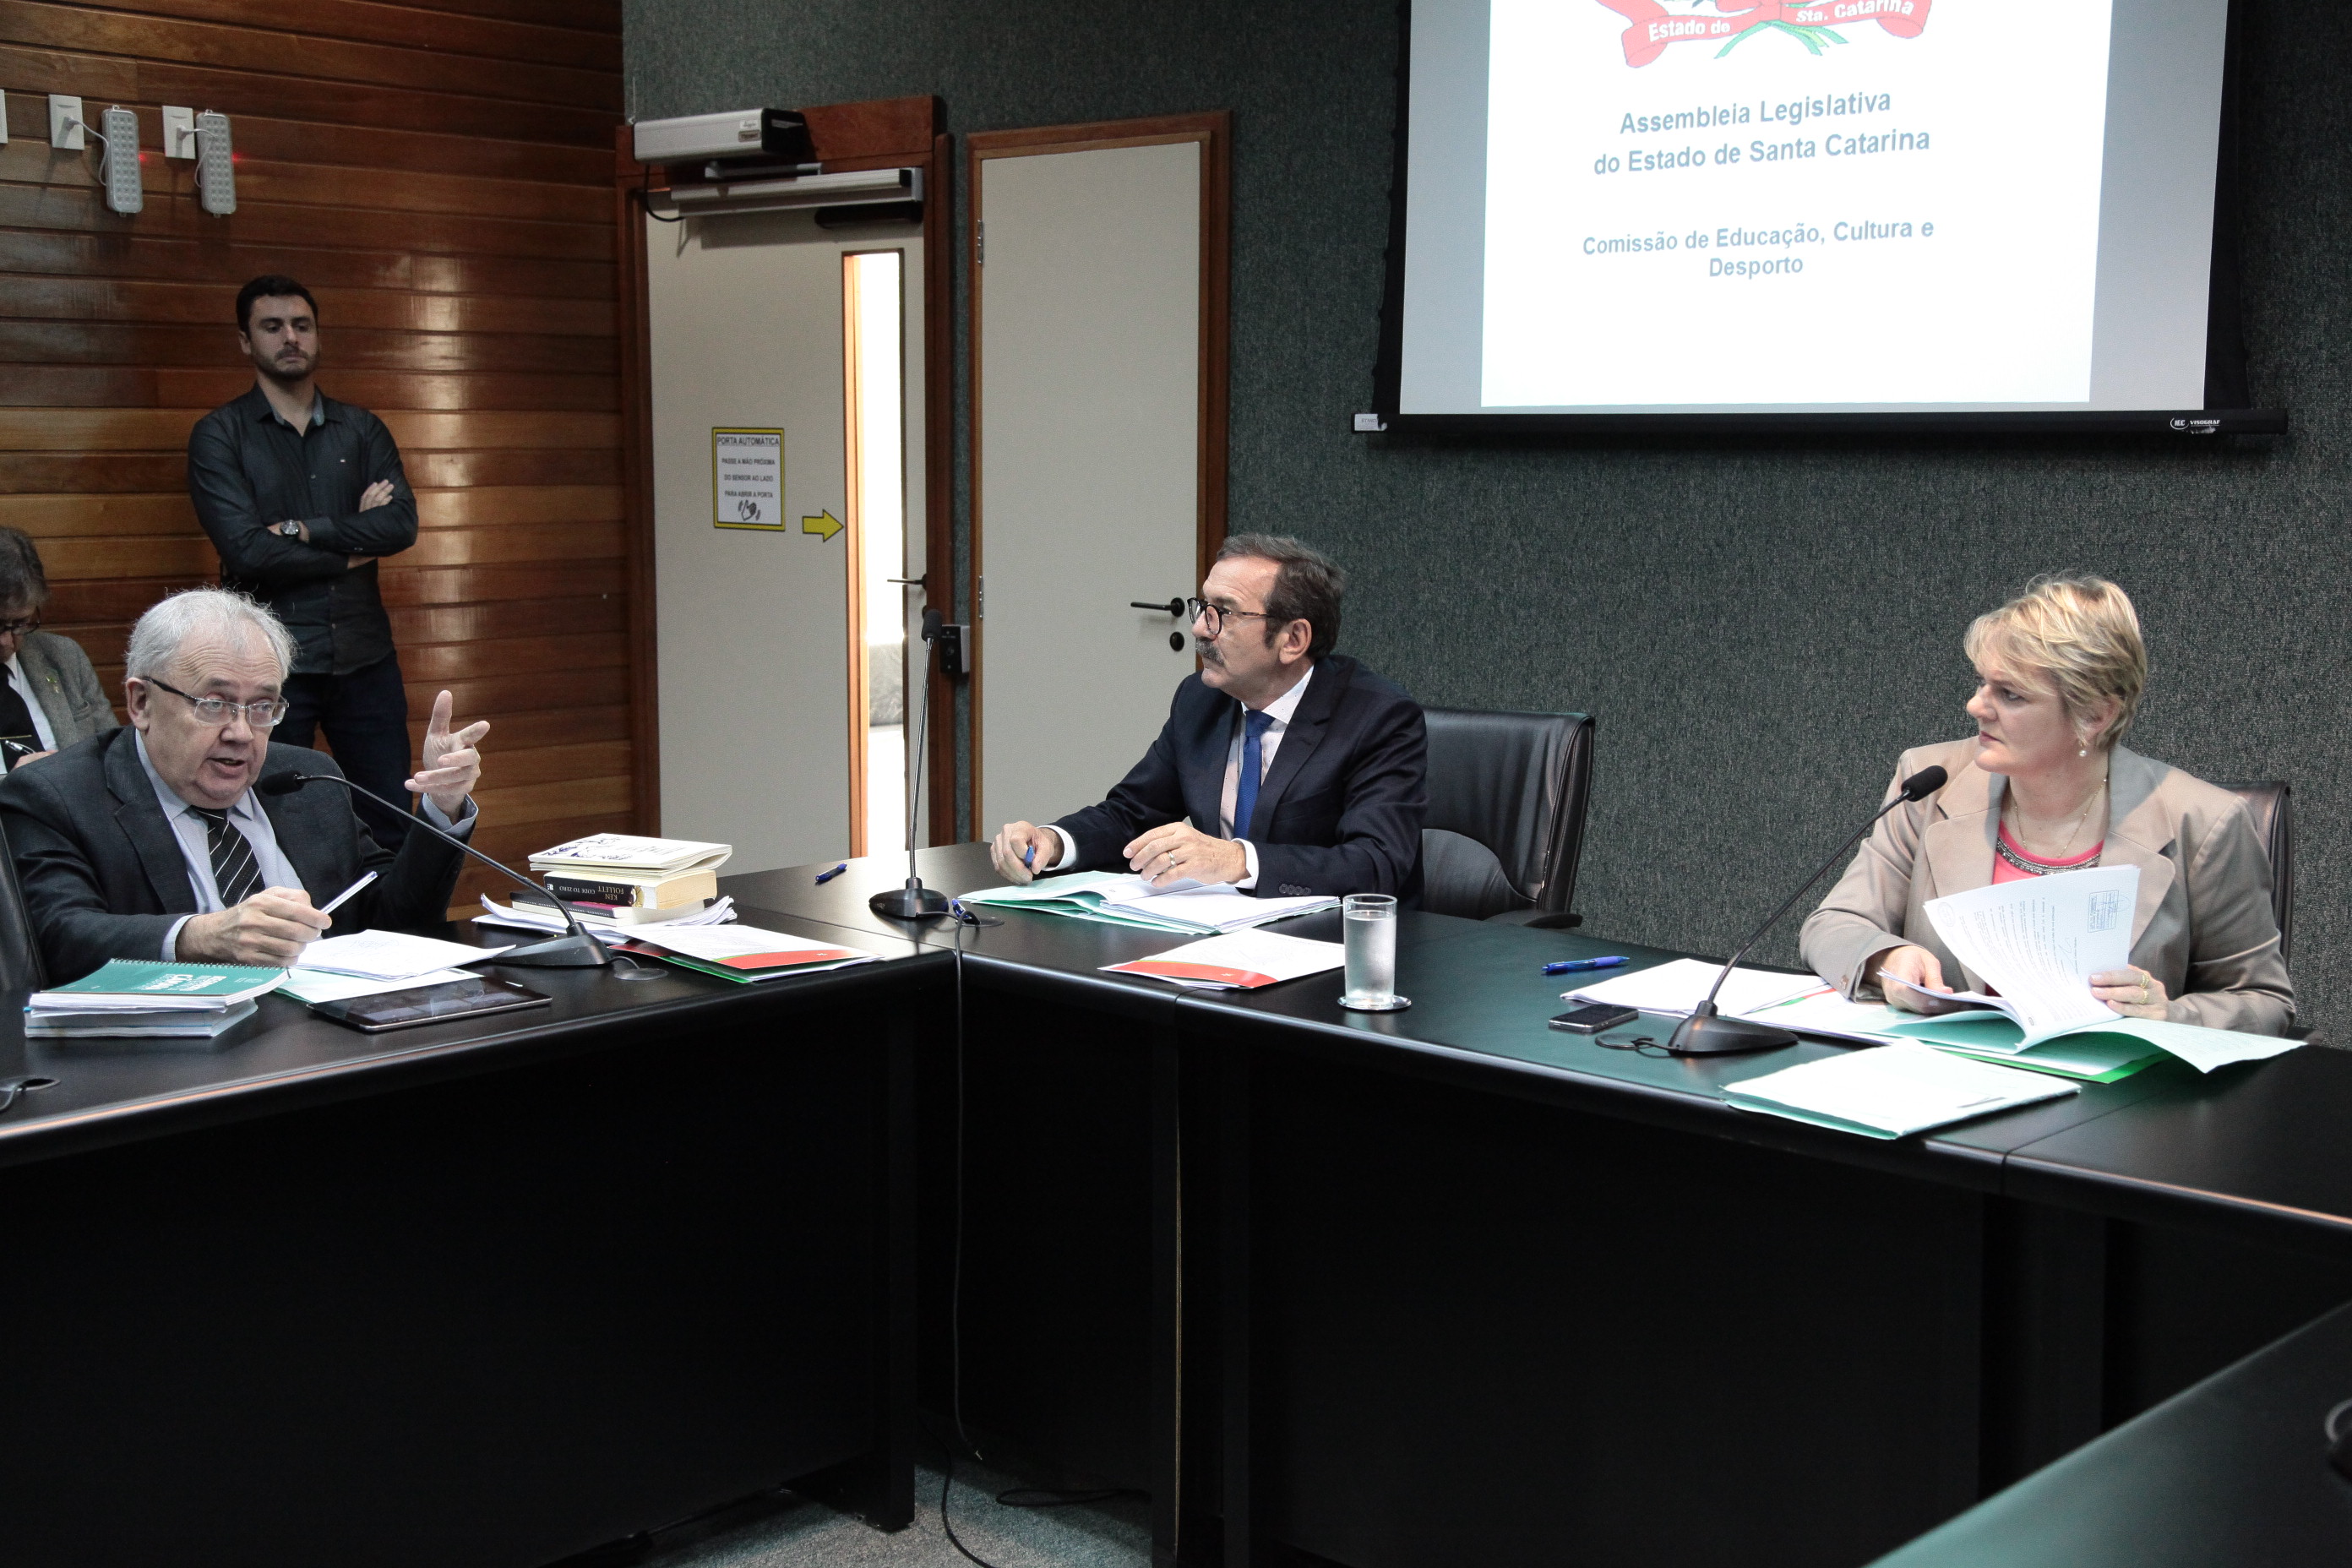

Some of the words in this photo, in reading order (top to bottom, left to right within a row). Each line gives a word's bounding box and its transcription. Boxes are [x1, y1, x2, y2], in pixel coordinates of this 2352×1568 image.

[1795, 10, 1828, 22] Sta.
[1648, 19, 1706, 42] Estado
[1711, 19, 1731, 35] de
[1620, 102, 1750, 134] Assembleia
[1760, 91, 1891, 126] Legislativa
[1593, 153, 1620, 176] do
[1628, 145, 1707, 172] Estado
[1714, 143, 1741, 166] de
[1749, 137, 1816, 163] Santa
[1825, 128, 1930, 156] Catarina
[1582, 231, 1679, 255] Comissão
[1685, 229, 1710, 249] de
[1716, 222, 1826, 249] Educação,
[1833, 220, 1913, 242] Cultura
[1920, 221, 1935, 237] e
[1709, 256, 1804, 280] Desporto
[717, 436, 737, 445] PORTA
[738, 436, 779, 446] AUTOMÁTICA
[597, 885, 624, 895] FOLLETT
